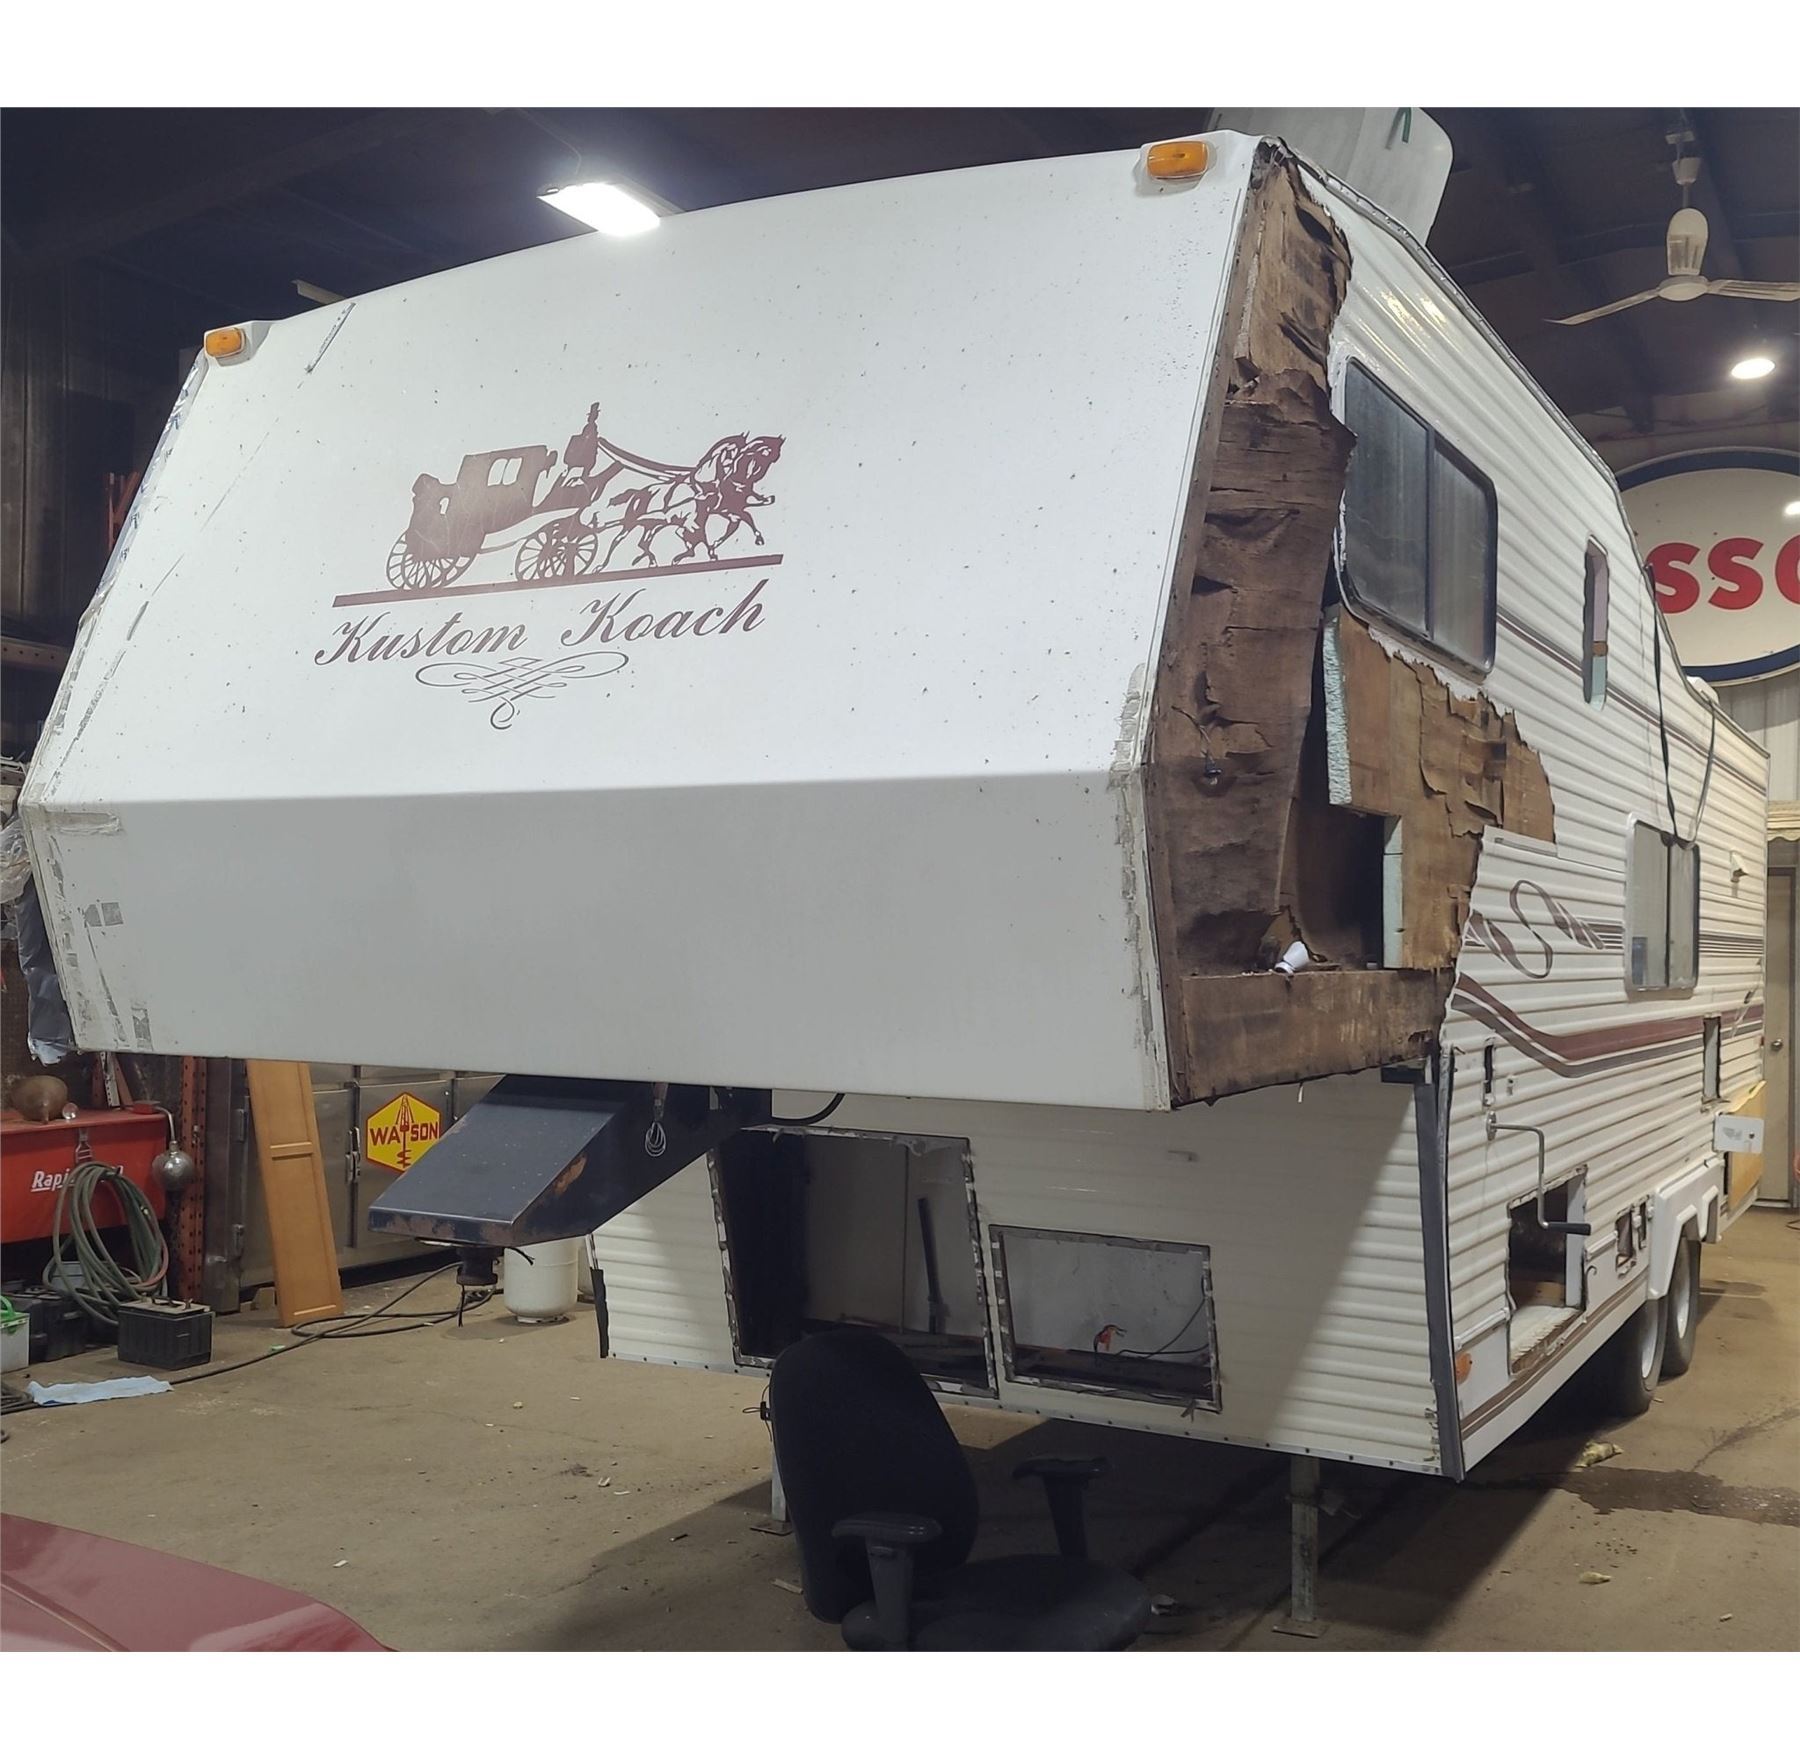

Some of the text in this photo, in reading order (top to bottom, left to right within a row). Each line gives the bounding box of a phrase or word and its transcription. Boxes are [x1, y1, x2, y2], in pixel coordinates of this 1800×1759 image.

[1644, 535, 1800, 614] SS
[314, 578, 770, 665] Kustom Koach
